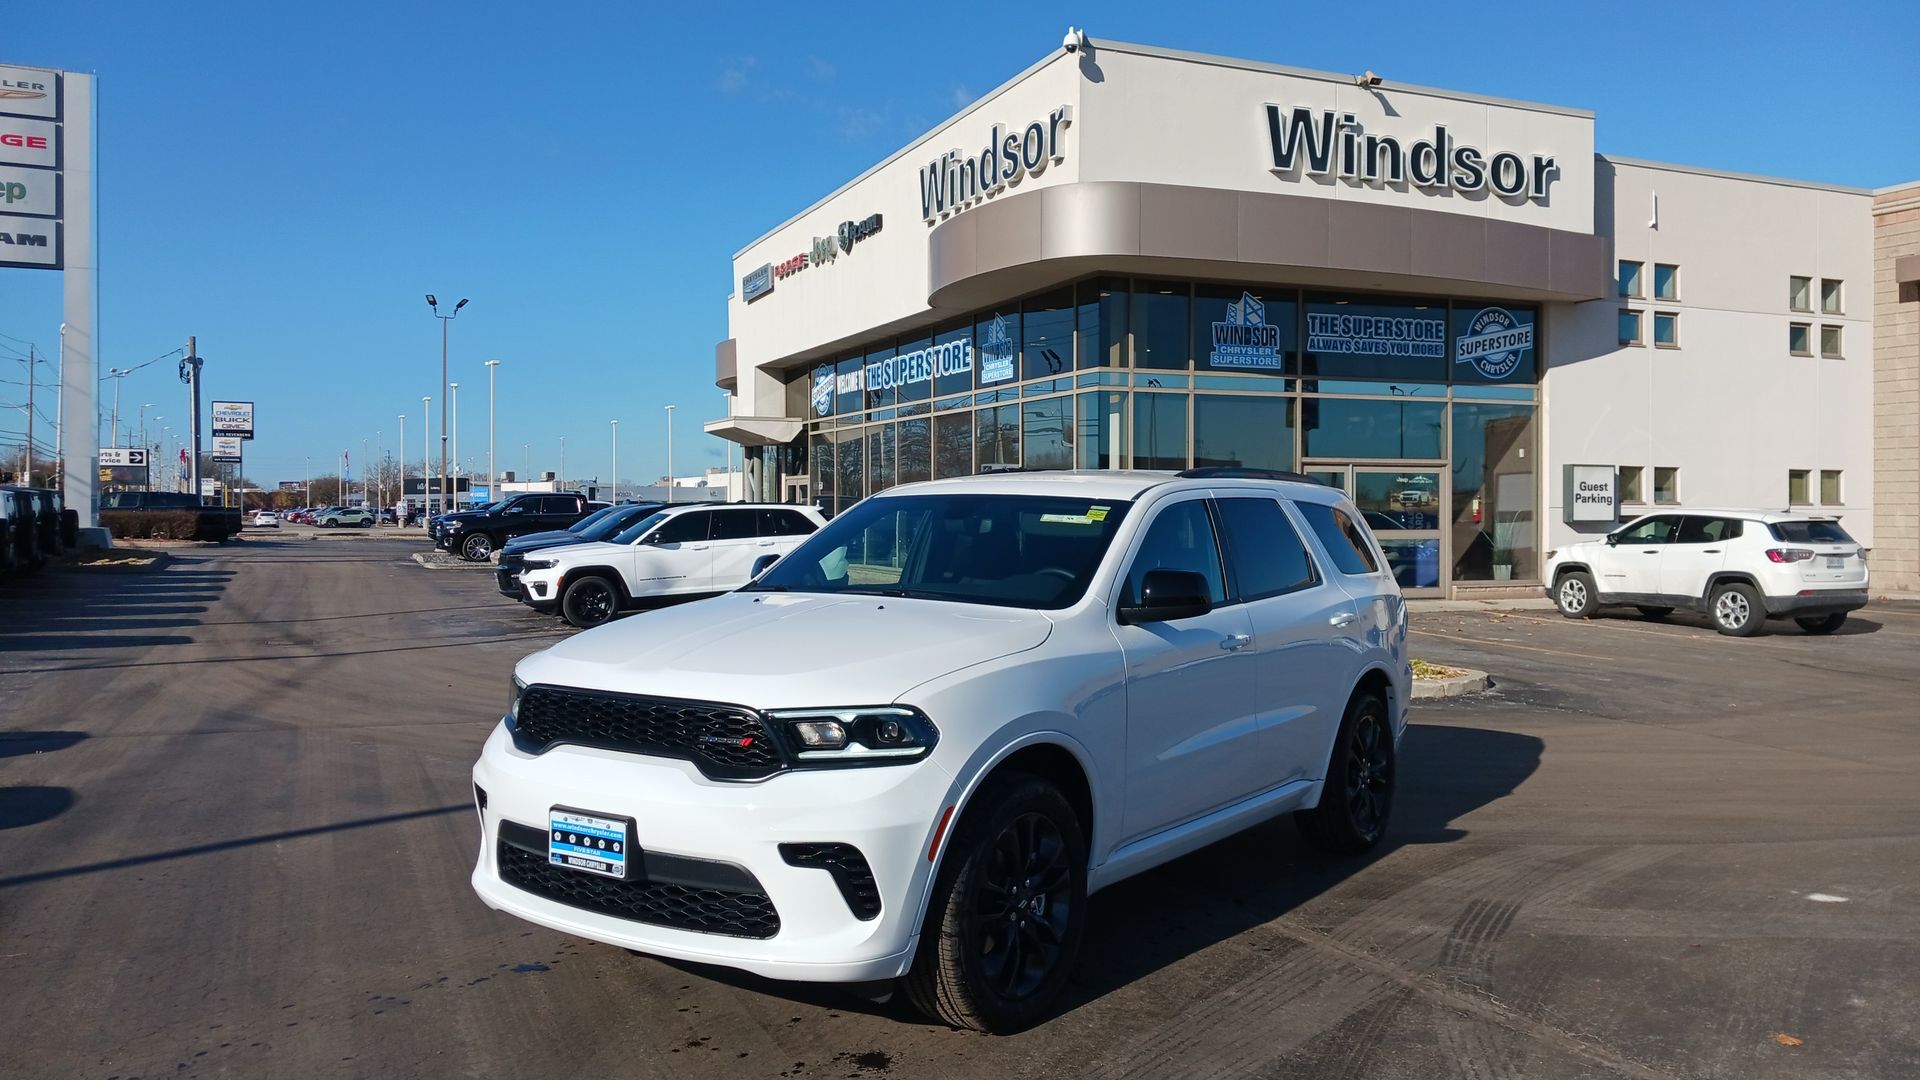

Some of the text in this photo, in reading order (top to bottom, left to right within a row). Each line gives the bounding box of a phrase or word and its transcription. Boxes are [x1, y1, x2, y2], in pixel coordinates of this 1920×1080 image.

[1264, 102, 1557, 199] Windsor
[919, 104, 1073, 222] Windsor
[1308, 314, 1444, 341] THE SUPERSTORE
[1474, 312, 1510, 331] WINDSOR
[1214, 324, 1278, 347] WINDSOR
[1459, 331, 1530, 356] SUPERSTORE
[1220, 346, 1272, 355] CHRYSLER
[1308, 337, 1444, 357] ALWAYS SAVES YOU MORE!
[866, 338, 972, 391] THE SUPERSTORE
[1213, 355, 1279, 366] SUPERSTORE
[1480, 353, 1516, 374] CHRYSLER
[1579, 481, 1609, 492] Guest
[1575, 493, 1613, 506] Parking
